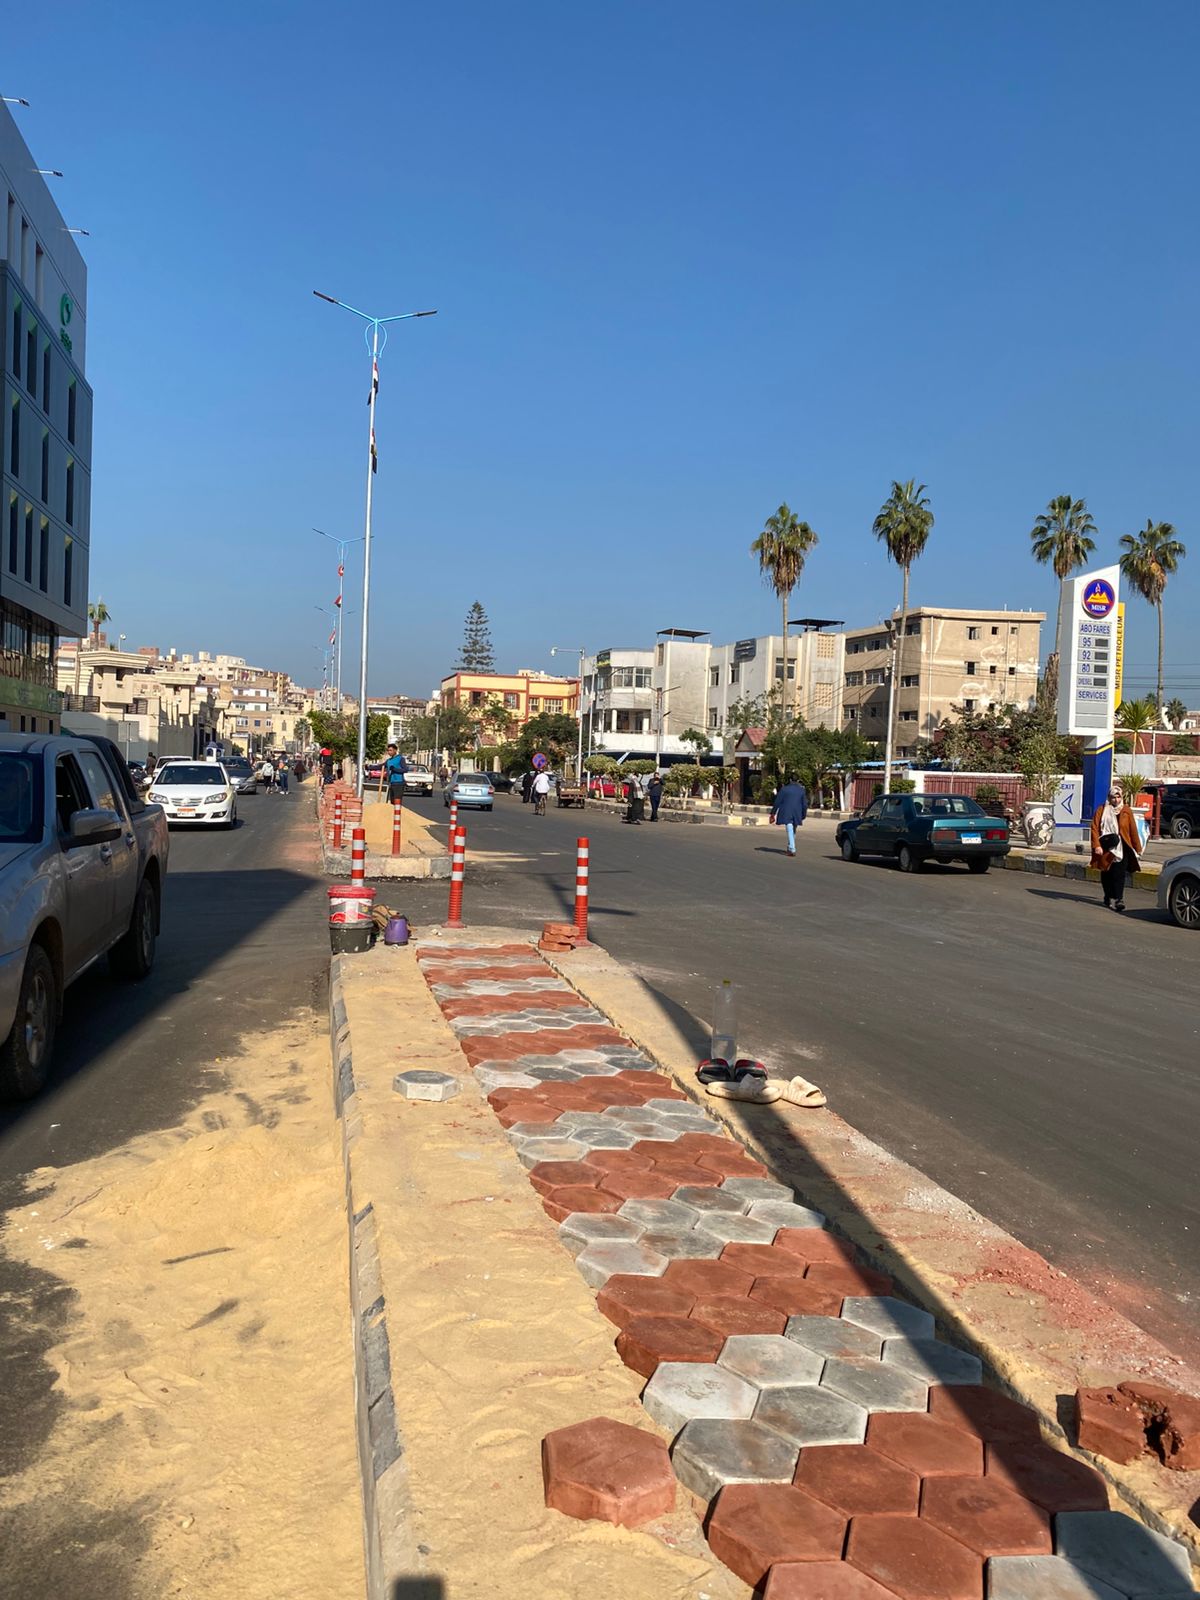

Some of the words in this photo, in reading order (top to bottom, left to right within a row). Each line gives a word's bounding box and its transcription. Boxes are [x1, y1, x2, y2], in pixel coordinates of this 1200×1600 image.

[1081, 624, 1092, 633] ABO
[1093, 624, 1110, 635] FARES
[1083, 637, 1091, 647] 95
[1083, 650, 1091, 660] 92
[1082, 663, 1090, 673] 80
[1078, 678, 1092, 686] DIESEL
[1078, 690, 1107, 700] SERVICES
